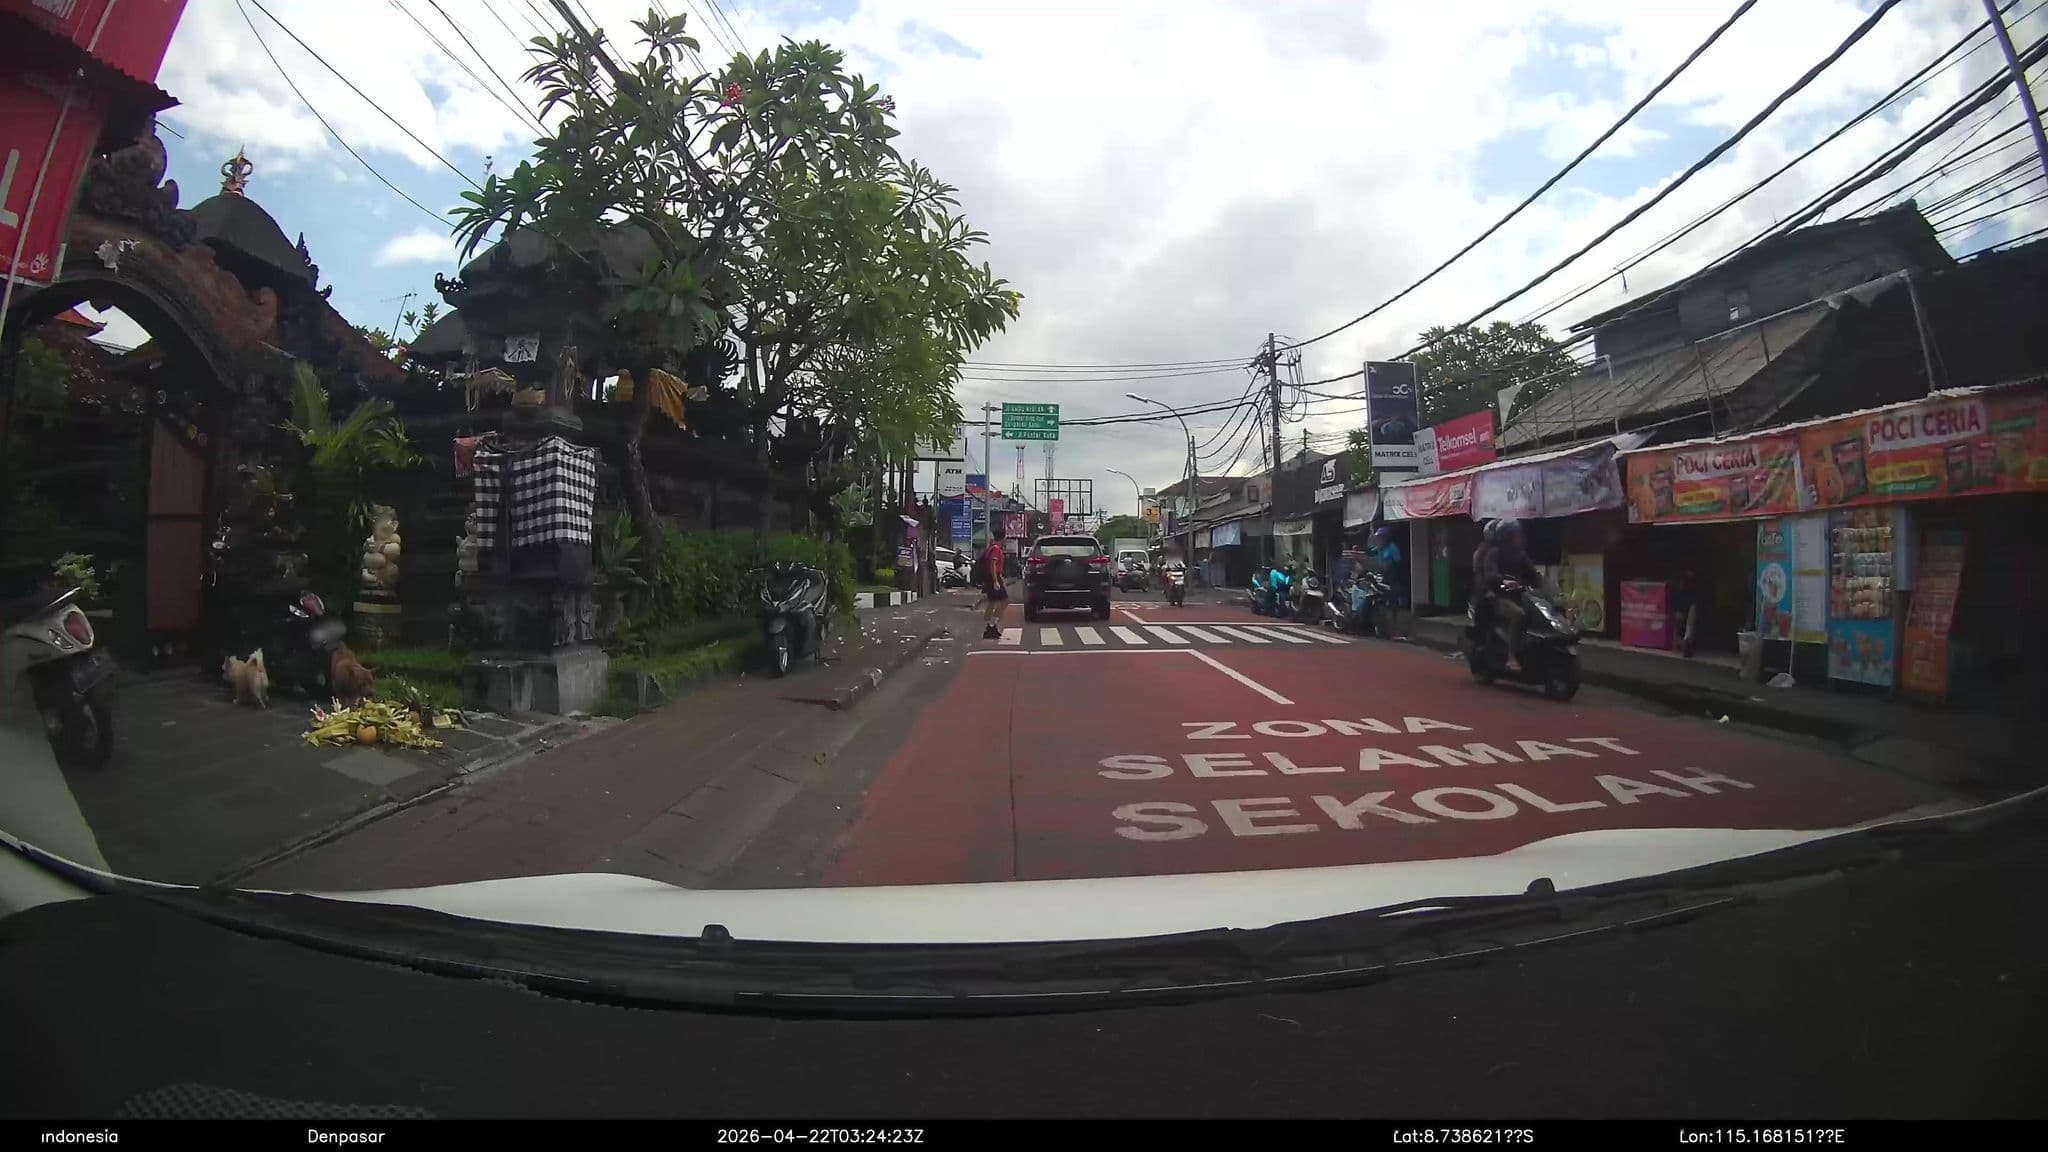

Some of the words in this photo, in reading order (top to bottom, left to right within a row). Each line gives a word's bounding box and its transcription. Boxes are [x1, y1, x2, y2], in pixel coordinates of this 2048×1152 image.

[1870, 418, 1916, 443] POCI
[1922, 405, 1981, 436] CERIA
[1438, 428, 1477, 453] Telkomsel
[1676, 455, 1708, 475] POCI
[1711, 448, 1756, 471] CERIA
[1181, 717, 1473, 739] ZONA
[1097, 737, 1640, 780] SELAMAT
[1111, 767, 1756, 842] SEKOLAH
